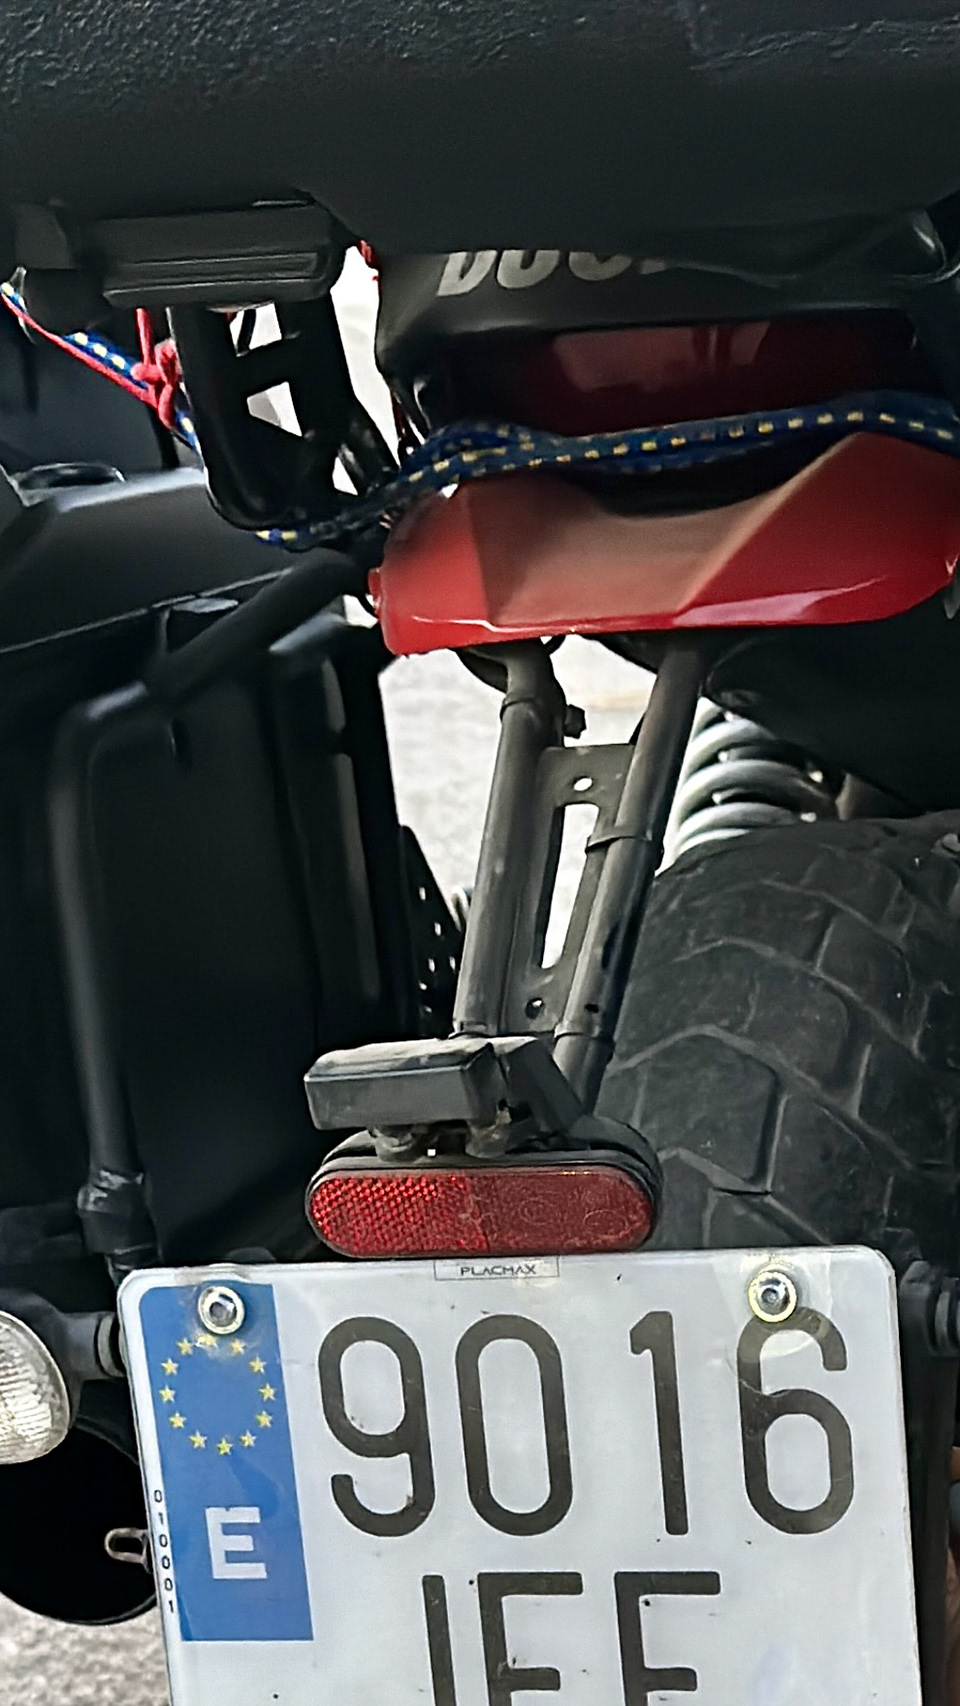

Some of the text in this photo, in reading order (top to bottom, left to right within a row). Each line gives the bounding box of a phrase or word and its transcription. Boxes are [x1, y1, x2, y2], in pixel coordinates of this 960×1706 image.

[460, 1264, 537, 1276] PLACMAX
[318, 1306, 854, 1538] 9016
[205, 1506, 267, 1579] E
